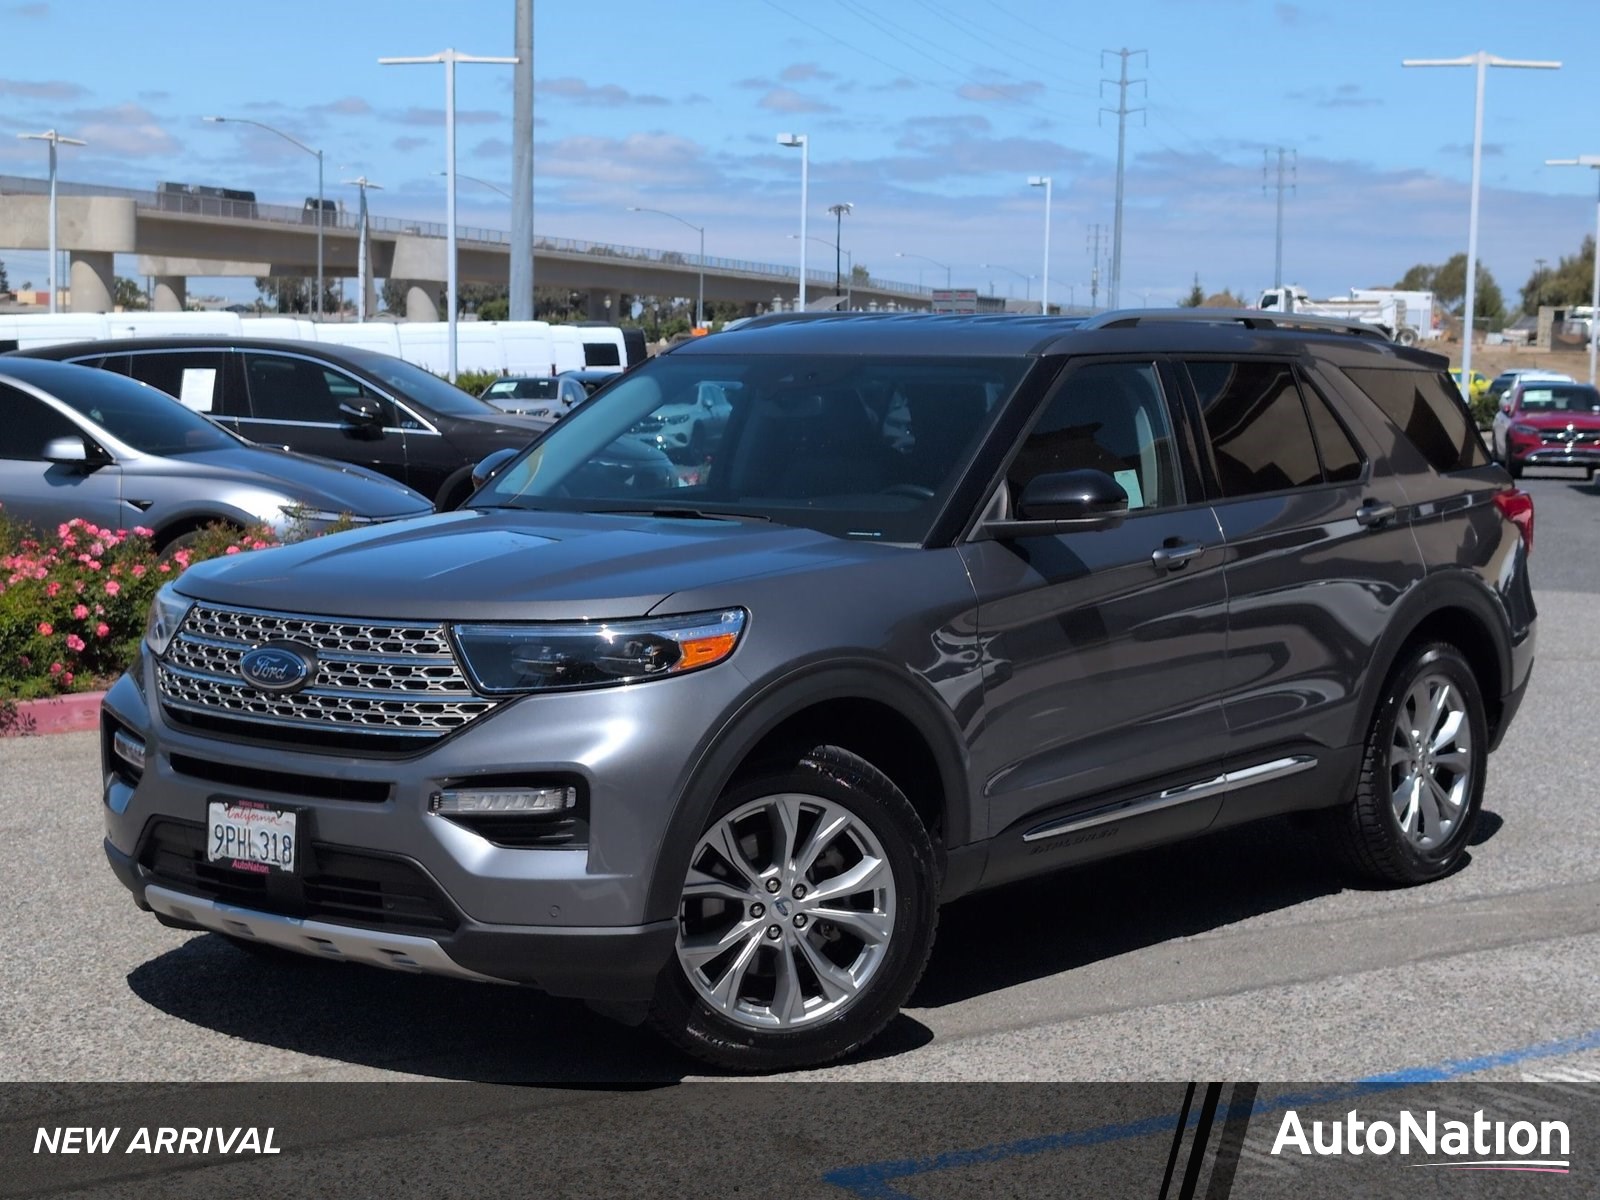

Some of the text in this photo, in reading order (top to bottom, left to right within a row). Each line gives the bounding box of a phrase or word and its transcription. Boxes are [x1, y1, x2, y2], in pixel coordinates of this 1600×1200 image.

[252, 656, 288, 680] Ford
[226, 807, 281, 825] California
[214, 824, 292, 865] 9PHL318
[231, 859, 270, 874] AutoNation
